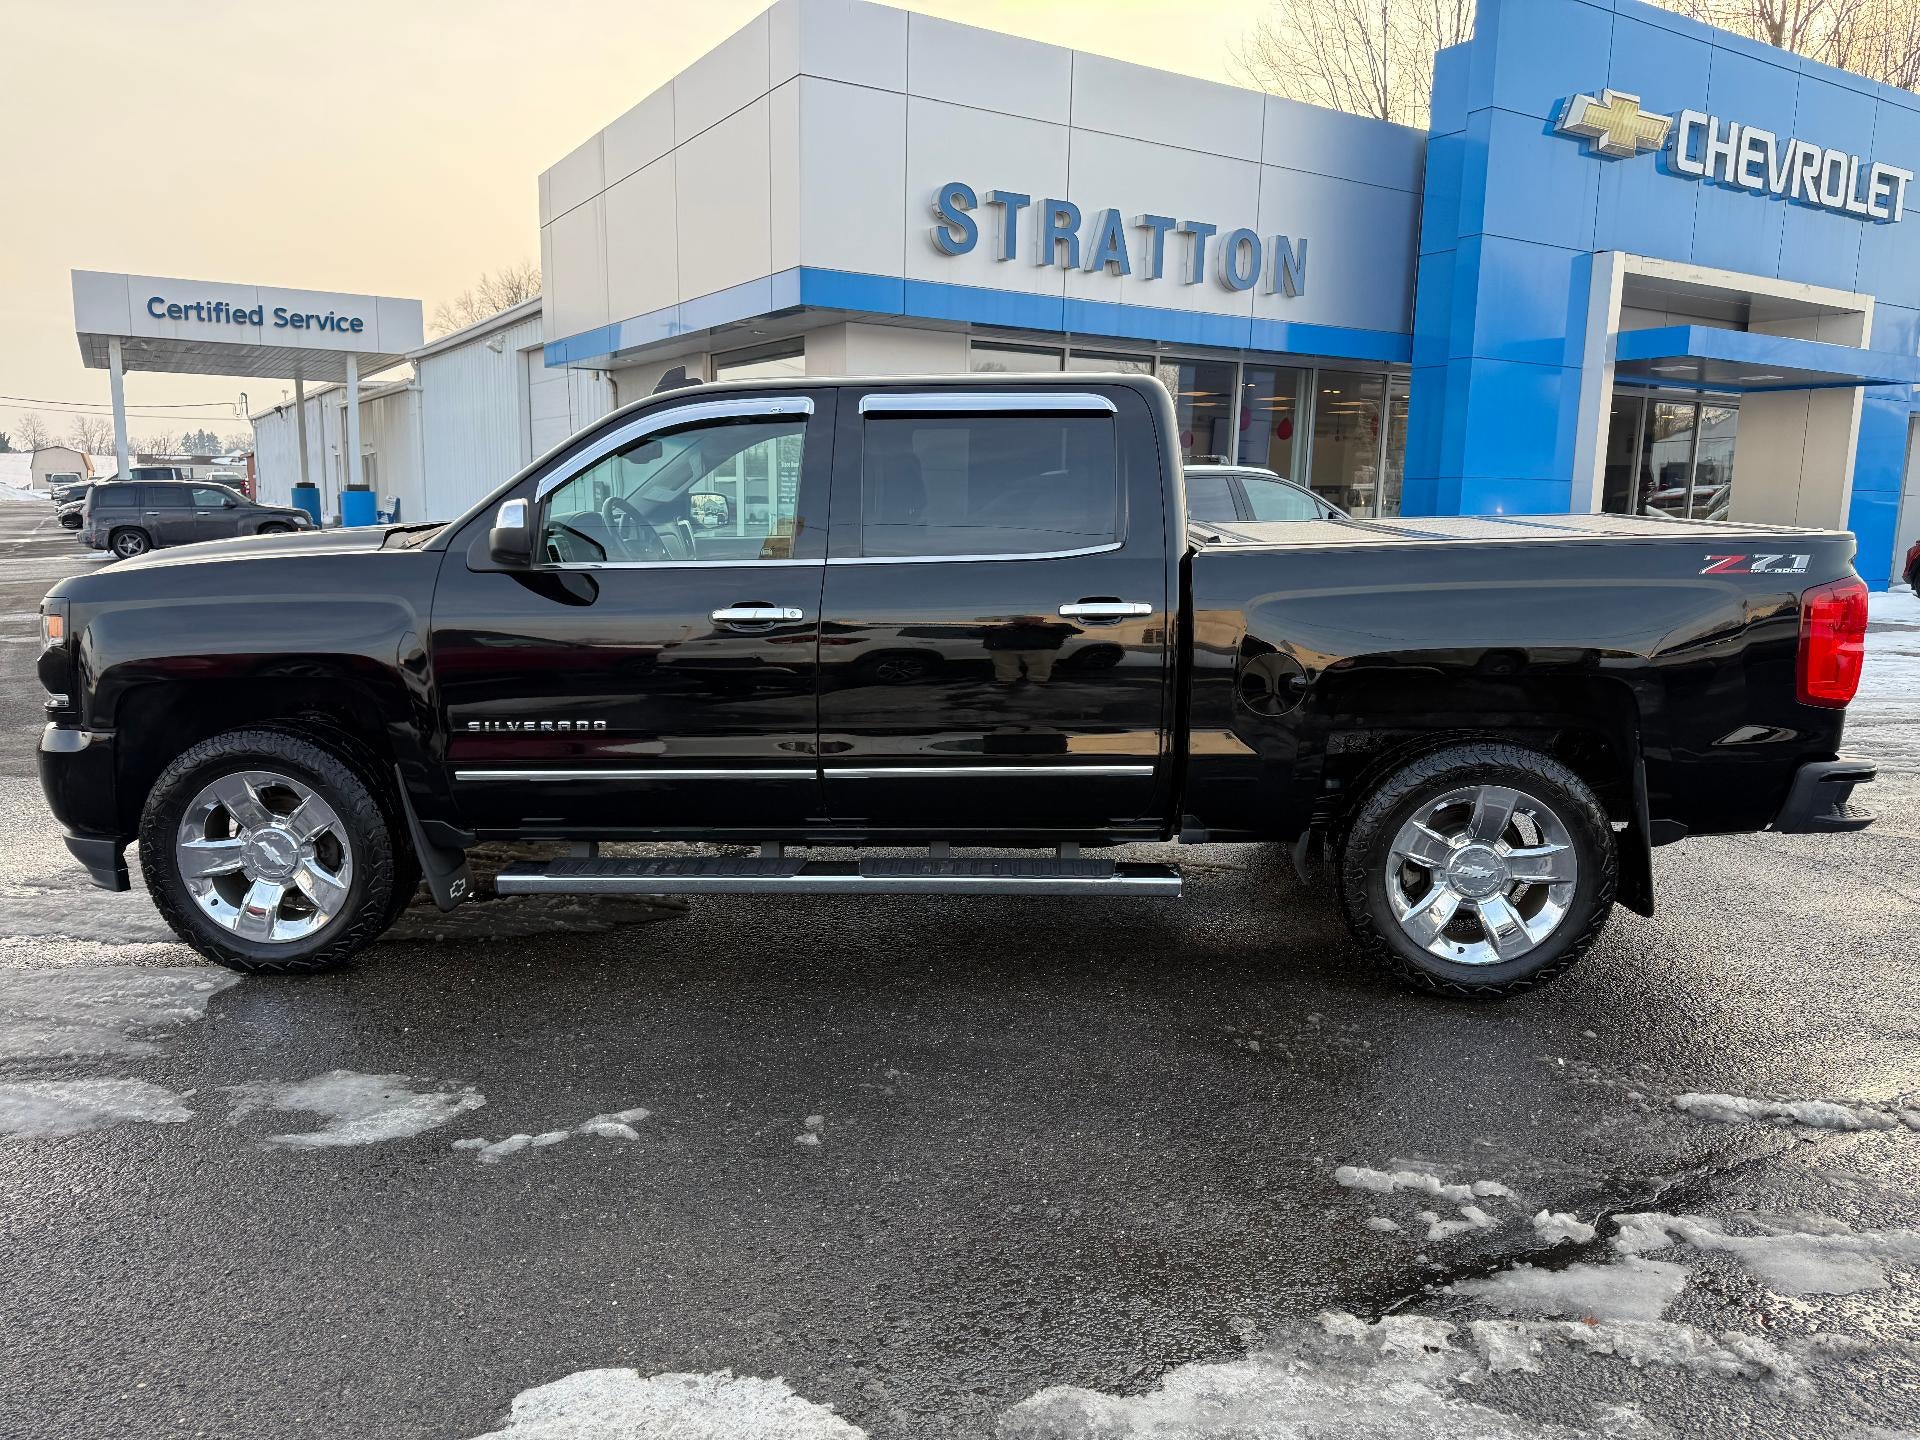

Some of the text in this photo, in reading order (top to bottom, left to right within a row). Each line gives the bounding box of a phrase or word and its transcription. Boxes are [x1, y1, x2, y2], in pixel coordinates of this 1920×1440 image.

[1670, 108, 1914, 223] CHEVROLET
[929, 181, 1308, 298] STRATTON
[146, 296, 364, 333] Certified Service
[1699, 554, 1811, 574] Z71
[467, 720, 607, 732] SILVERADO
